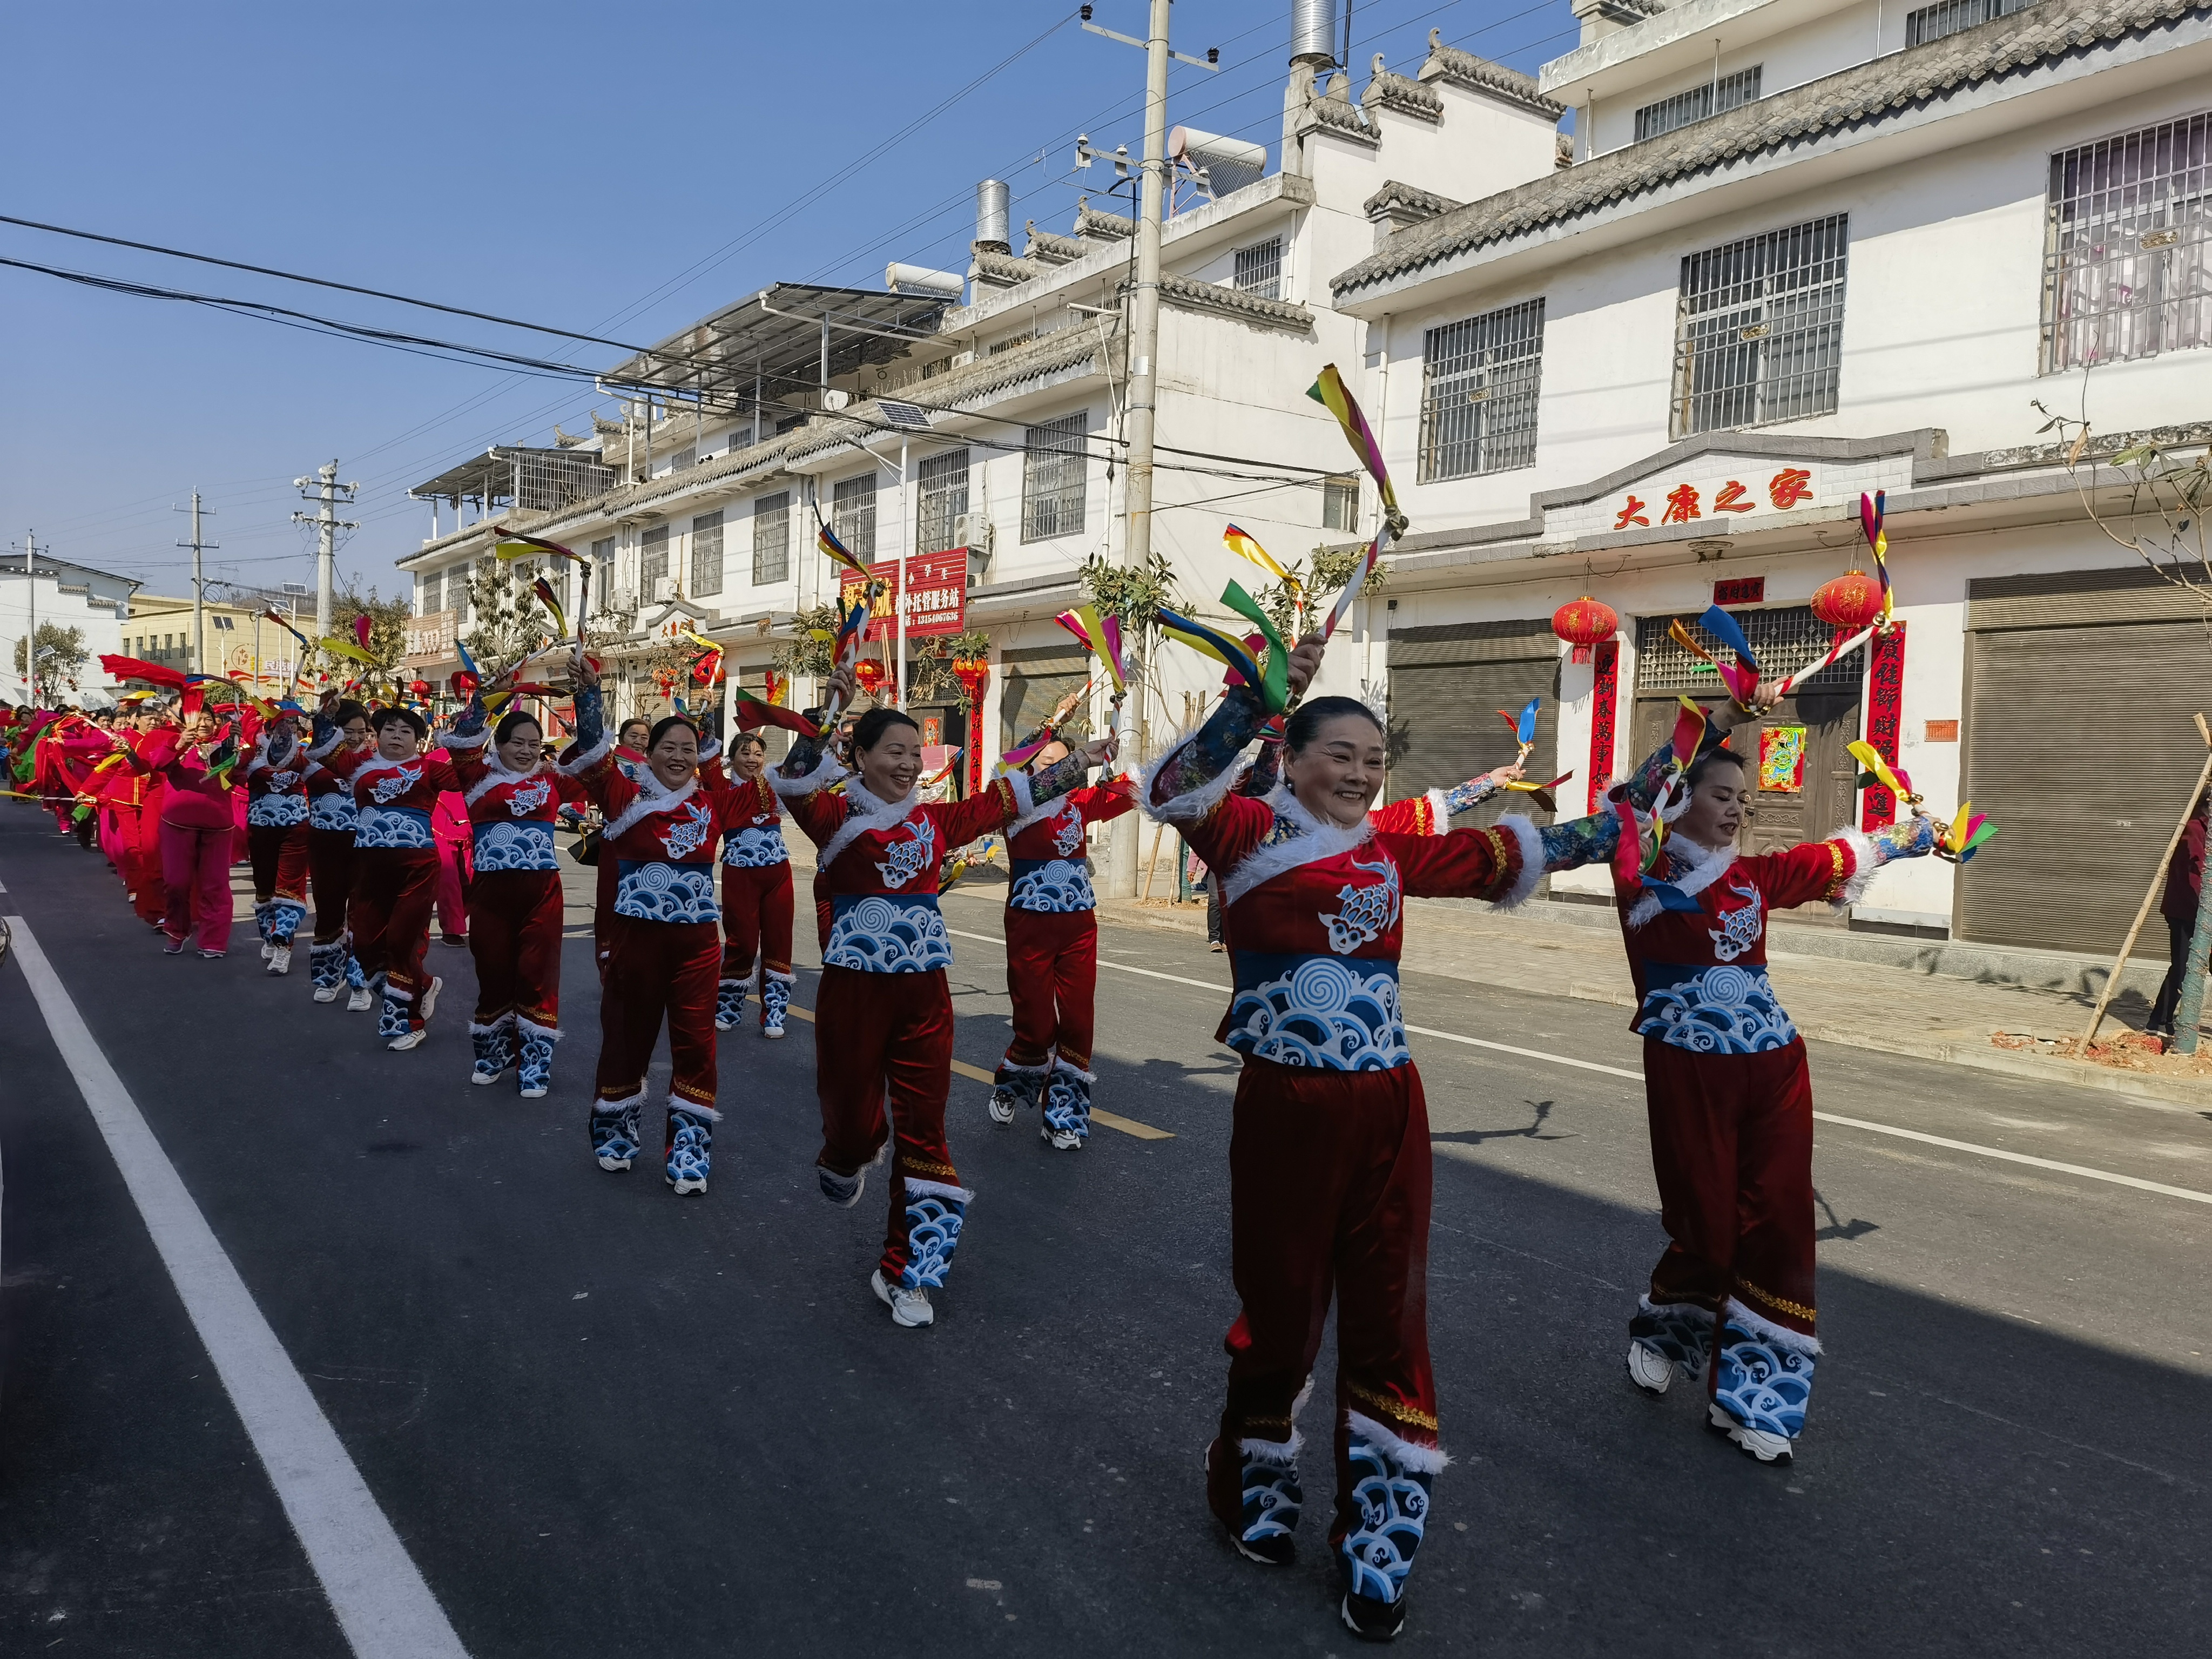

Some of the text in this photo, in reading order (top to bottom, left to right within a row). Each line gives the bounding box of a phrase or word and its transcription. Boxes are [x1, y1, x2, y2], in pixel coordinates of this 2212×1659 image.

[1613, 468, 1814, 530] 大康之家
[1590, 653, 1615, 806] 迎新春萬事如
